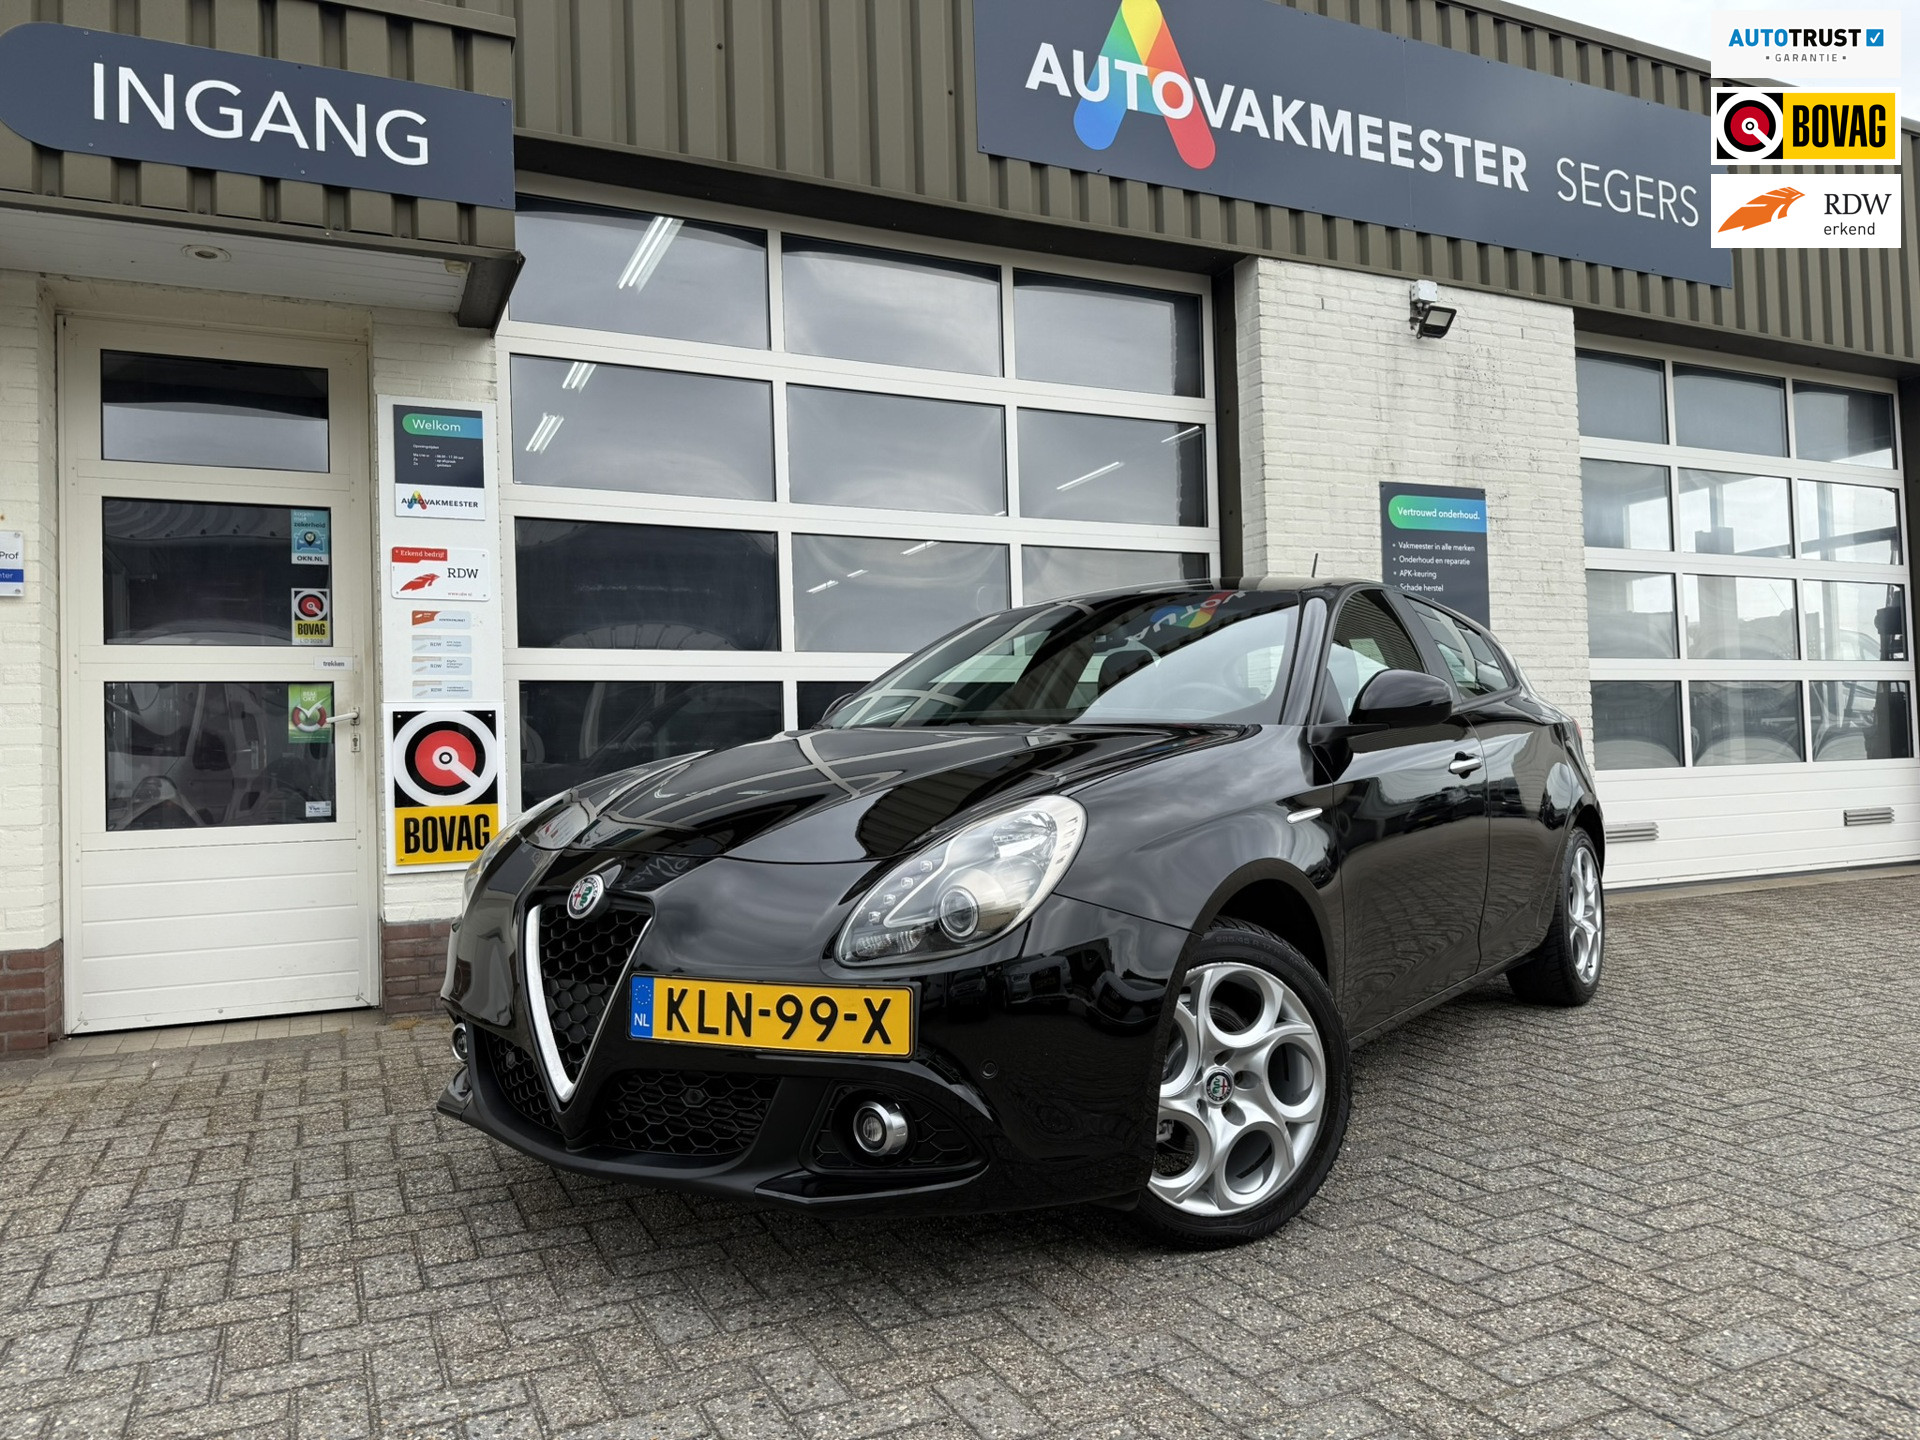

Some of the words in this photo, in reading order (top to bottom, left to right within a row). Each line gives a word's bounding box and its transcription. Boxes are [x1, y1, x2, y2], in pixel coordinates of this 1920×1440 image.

[94, 62, 429, 166] INGANG
[1025, 42, 1529, 192] AUTOVAKMEESTER
[1556, 157, 1699, 227] SEGERS
[412, 419, 461, 432] Welkom
[401, 495, 478, 508] AUTOVAKMEESTER
[1397, 507, 1436, 517] Vertrouwd
[1439, 511, 1480, 520] onderhoud.
[1399, 542, 1433, 550] Vakmeester
[1442, 543, 1451, 551] alle
[1453, 544, 1475, 552] merken
[1399, 555, 1434, 565] Onderhoud
[1444, 557, 1470, 567] reparatie
[447, 568, 478, 579] RDW
[1399, 570, 1437, 579] APK-keuring
[1400, 583, 1422, 591] Schade
[1424, 584, 1443, 592] herstel
[297, 623, 326, 636] BOVAG
[404, 814, 490, 854] BOVAG
[634, 1014, 650, 1028] NL
[666, 987, 892, 1045] KLN-99-X
